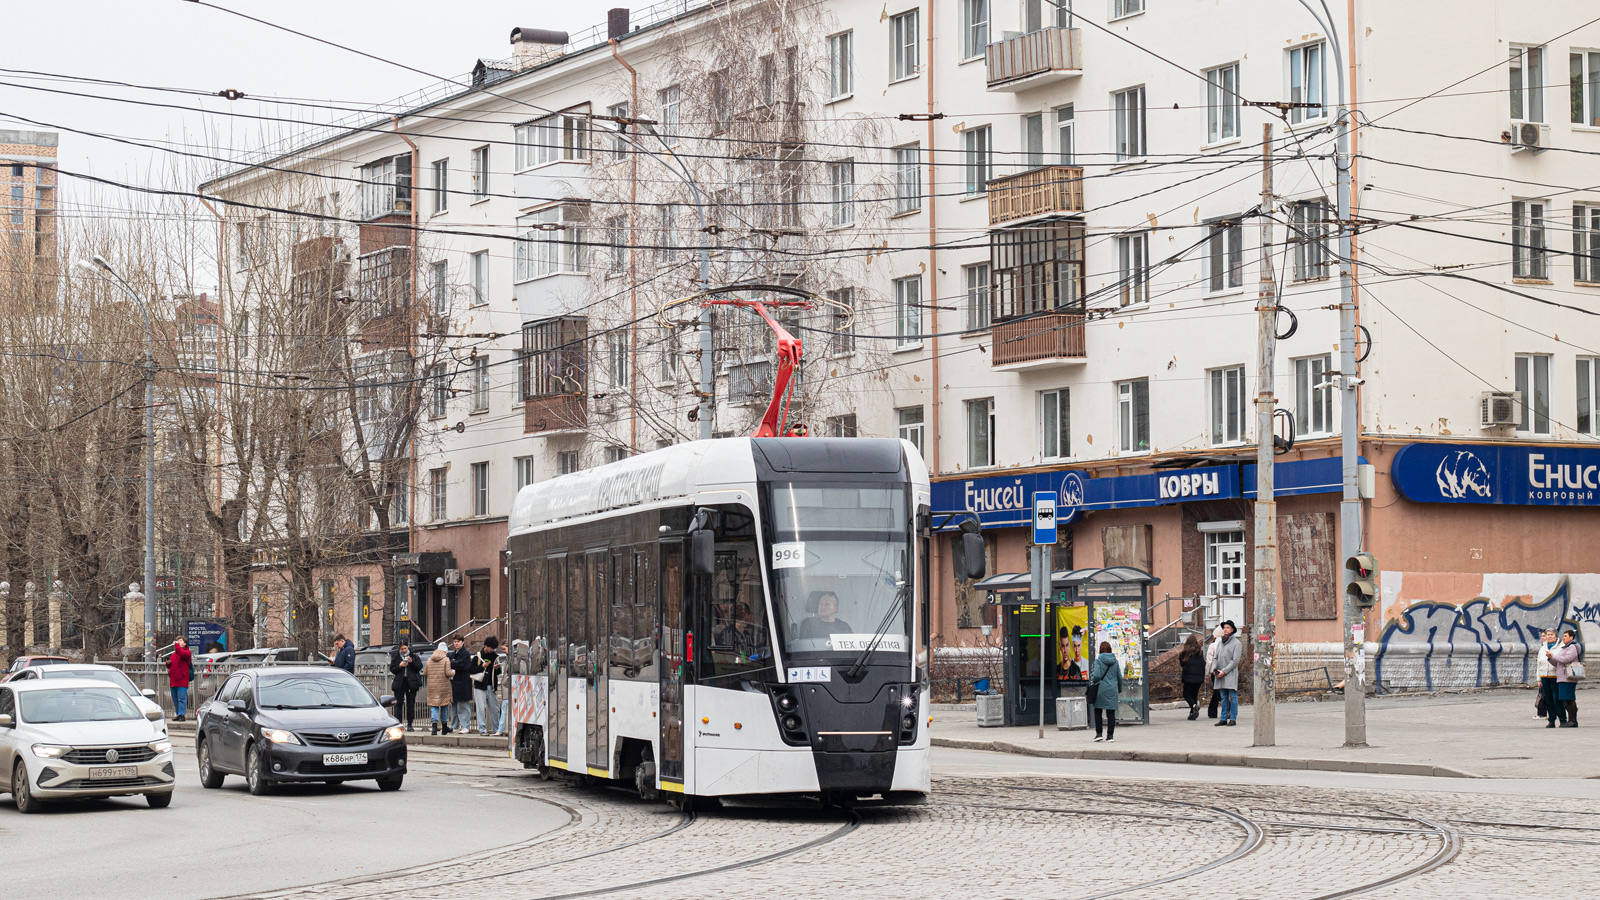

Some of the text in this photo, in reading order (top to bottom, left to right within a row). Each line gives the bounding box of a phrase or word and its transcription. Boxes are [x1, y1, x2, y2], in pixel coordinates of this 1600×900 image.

[1528, 453, 1600, 489] Енис
[1159, 472, 1219, 499] КОВРЫ
[965, 478, 1024, 512] Енисей
[1529, 491, 1593, 500] КОВРОВЫЙ
[775, 549, 801, 561] 996
[325, 754, 354, 763] К686НР
[92, 768, 123, 777] Н699УТ
